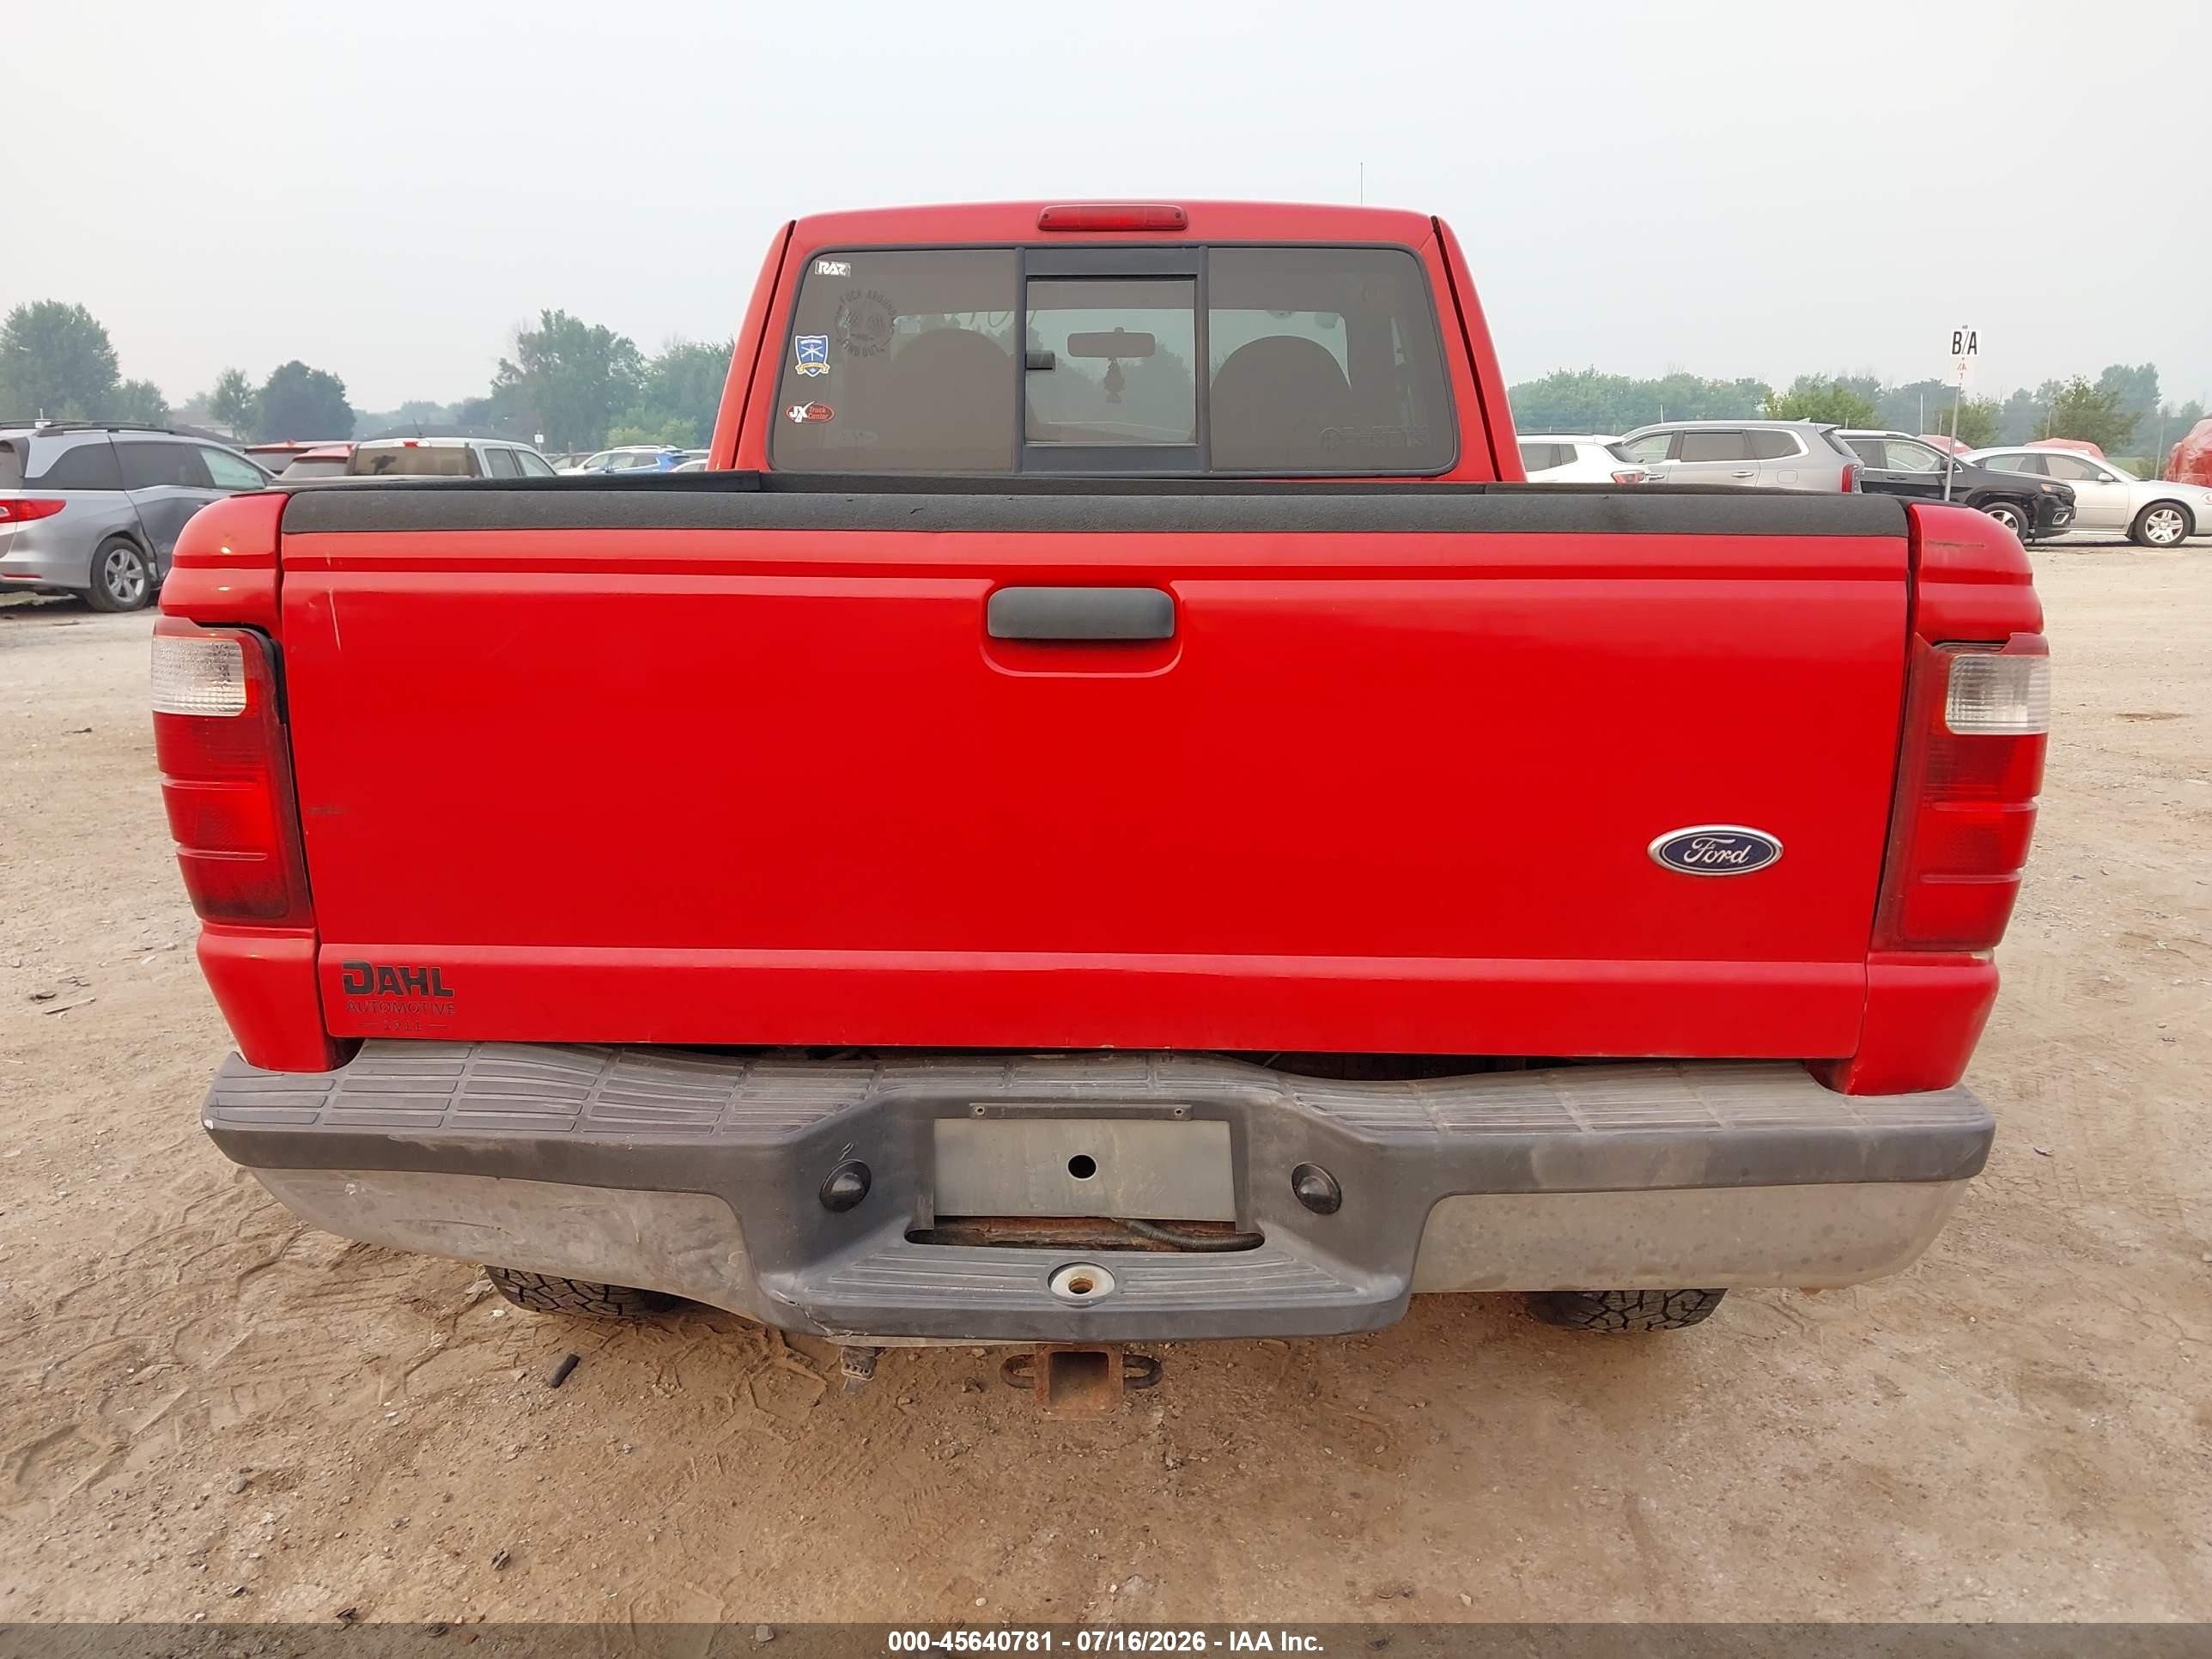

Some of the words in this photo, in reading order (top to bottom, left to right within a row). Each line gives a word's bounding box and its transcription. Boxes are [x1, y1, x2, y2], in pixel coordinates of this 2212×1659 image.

[1952, 331, 1978, 356] B/A
[1683, 836, 1753, 864] Ford
[343, 959, 454, 997] DAHL
[346, 1000, 454, 1015] AUTOMOTIVE
